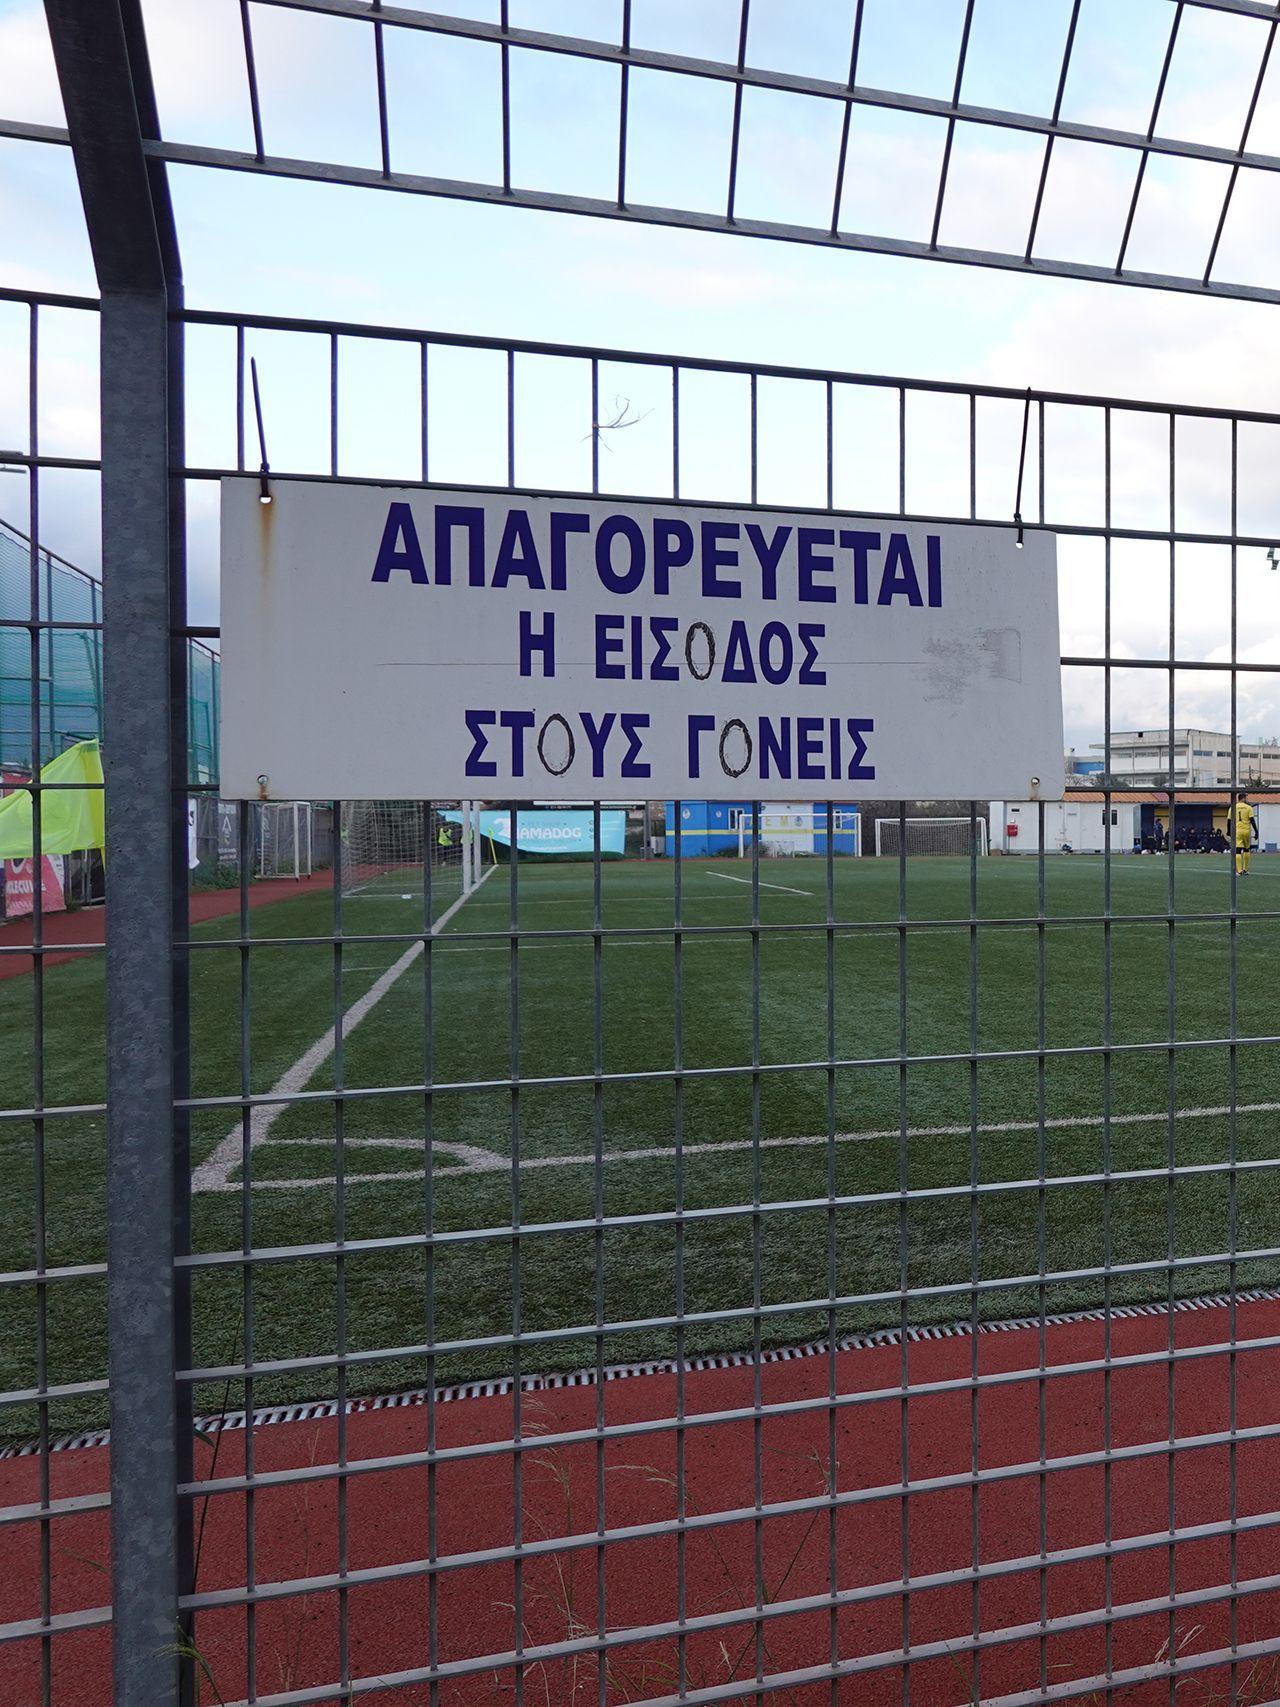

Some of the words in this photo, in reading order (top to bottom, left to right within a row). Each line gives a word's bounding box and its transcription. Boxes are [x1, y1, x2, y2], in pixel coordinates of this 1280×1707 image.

[372, 503, 941, 607] ΑΠΑΓΟΡΕΥΕΤΑΙ
[520, 611, 554, 676] Η
[596, 615, 827, 686] ΕΙΣΟΔΟΣ
[466, 711, 650, 778] ΣΤΟΥΣ
[689, 715, 876, 780] ΓΟΝΕΙΣ
[513, 827, 582, 840] AMADOG
